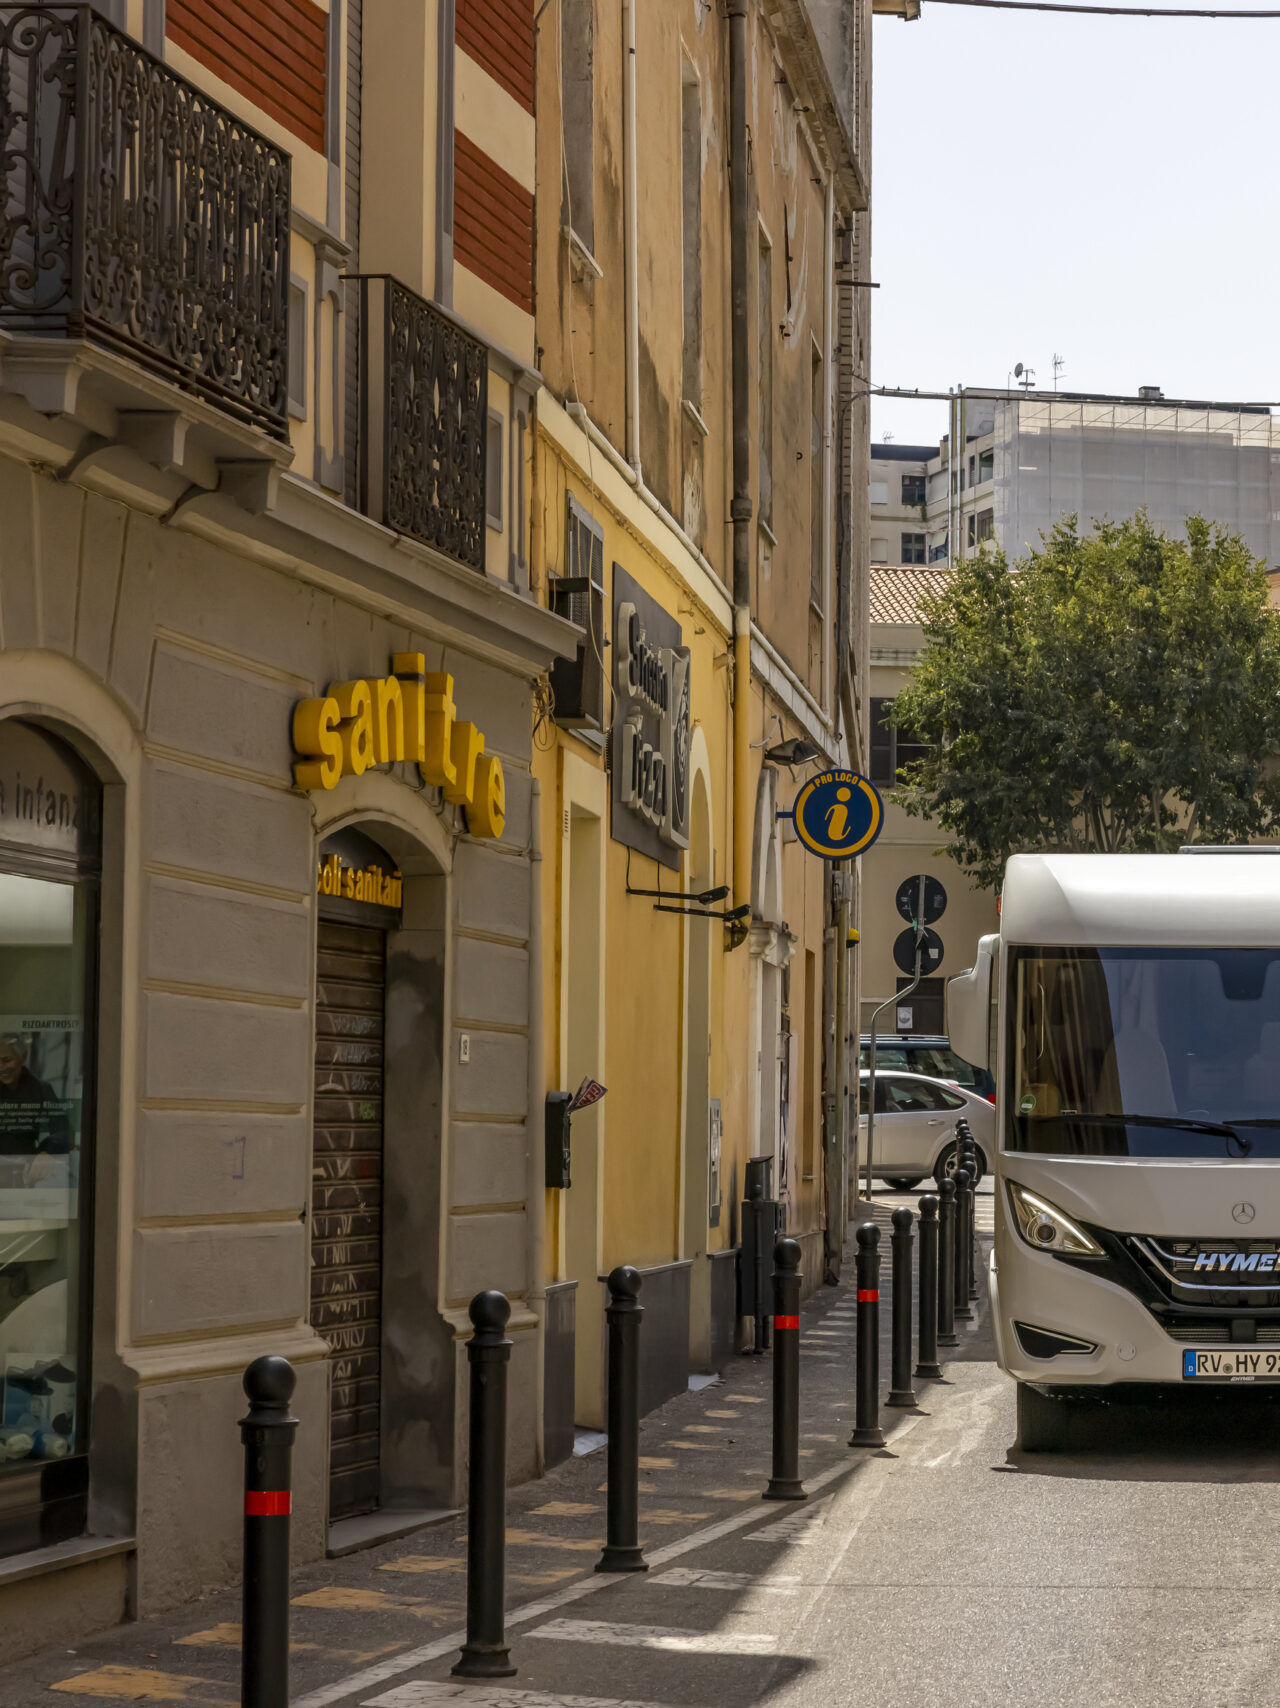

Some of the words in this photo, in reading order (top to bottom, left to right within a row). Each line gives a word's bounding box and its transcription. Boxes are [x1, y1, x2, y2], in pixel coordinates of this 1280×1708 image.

[293, 651, 506, 838] sanitre
[814, 773, 833, 788] PRO
[835, 772, 859, 785] LOCO
[343, 865, 402, 908] sanitari
[1197, 1354, 1222, 1373] RV
[1235, 1354, 1261, 1373] HY
